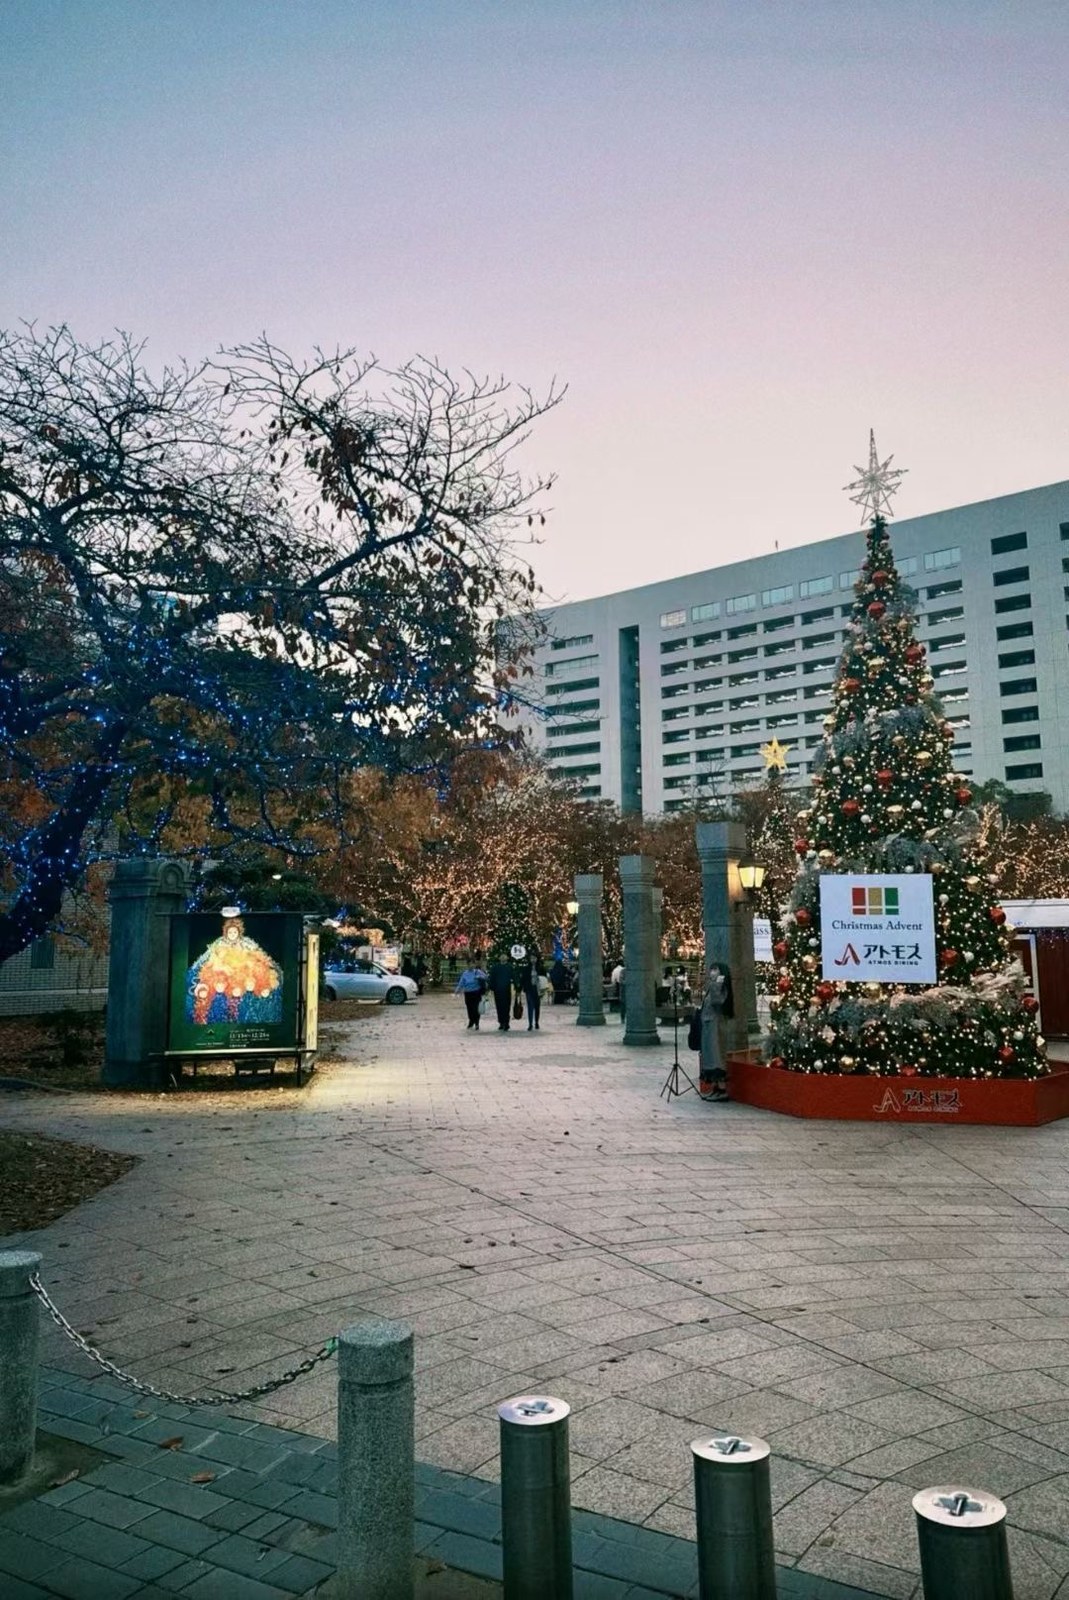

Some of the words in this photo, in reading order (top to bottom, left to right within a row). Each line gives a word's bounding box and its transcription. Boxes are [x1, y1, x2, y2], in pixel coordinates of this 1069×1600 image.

[832, 920, 883, 930] Christmas
[886, 921, 923, 930] Advent
[863, 943, 922, 960] アトモス
